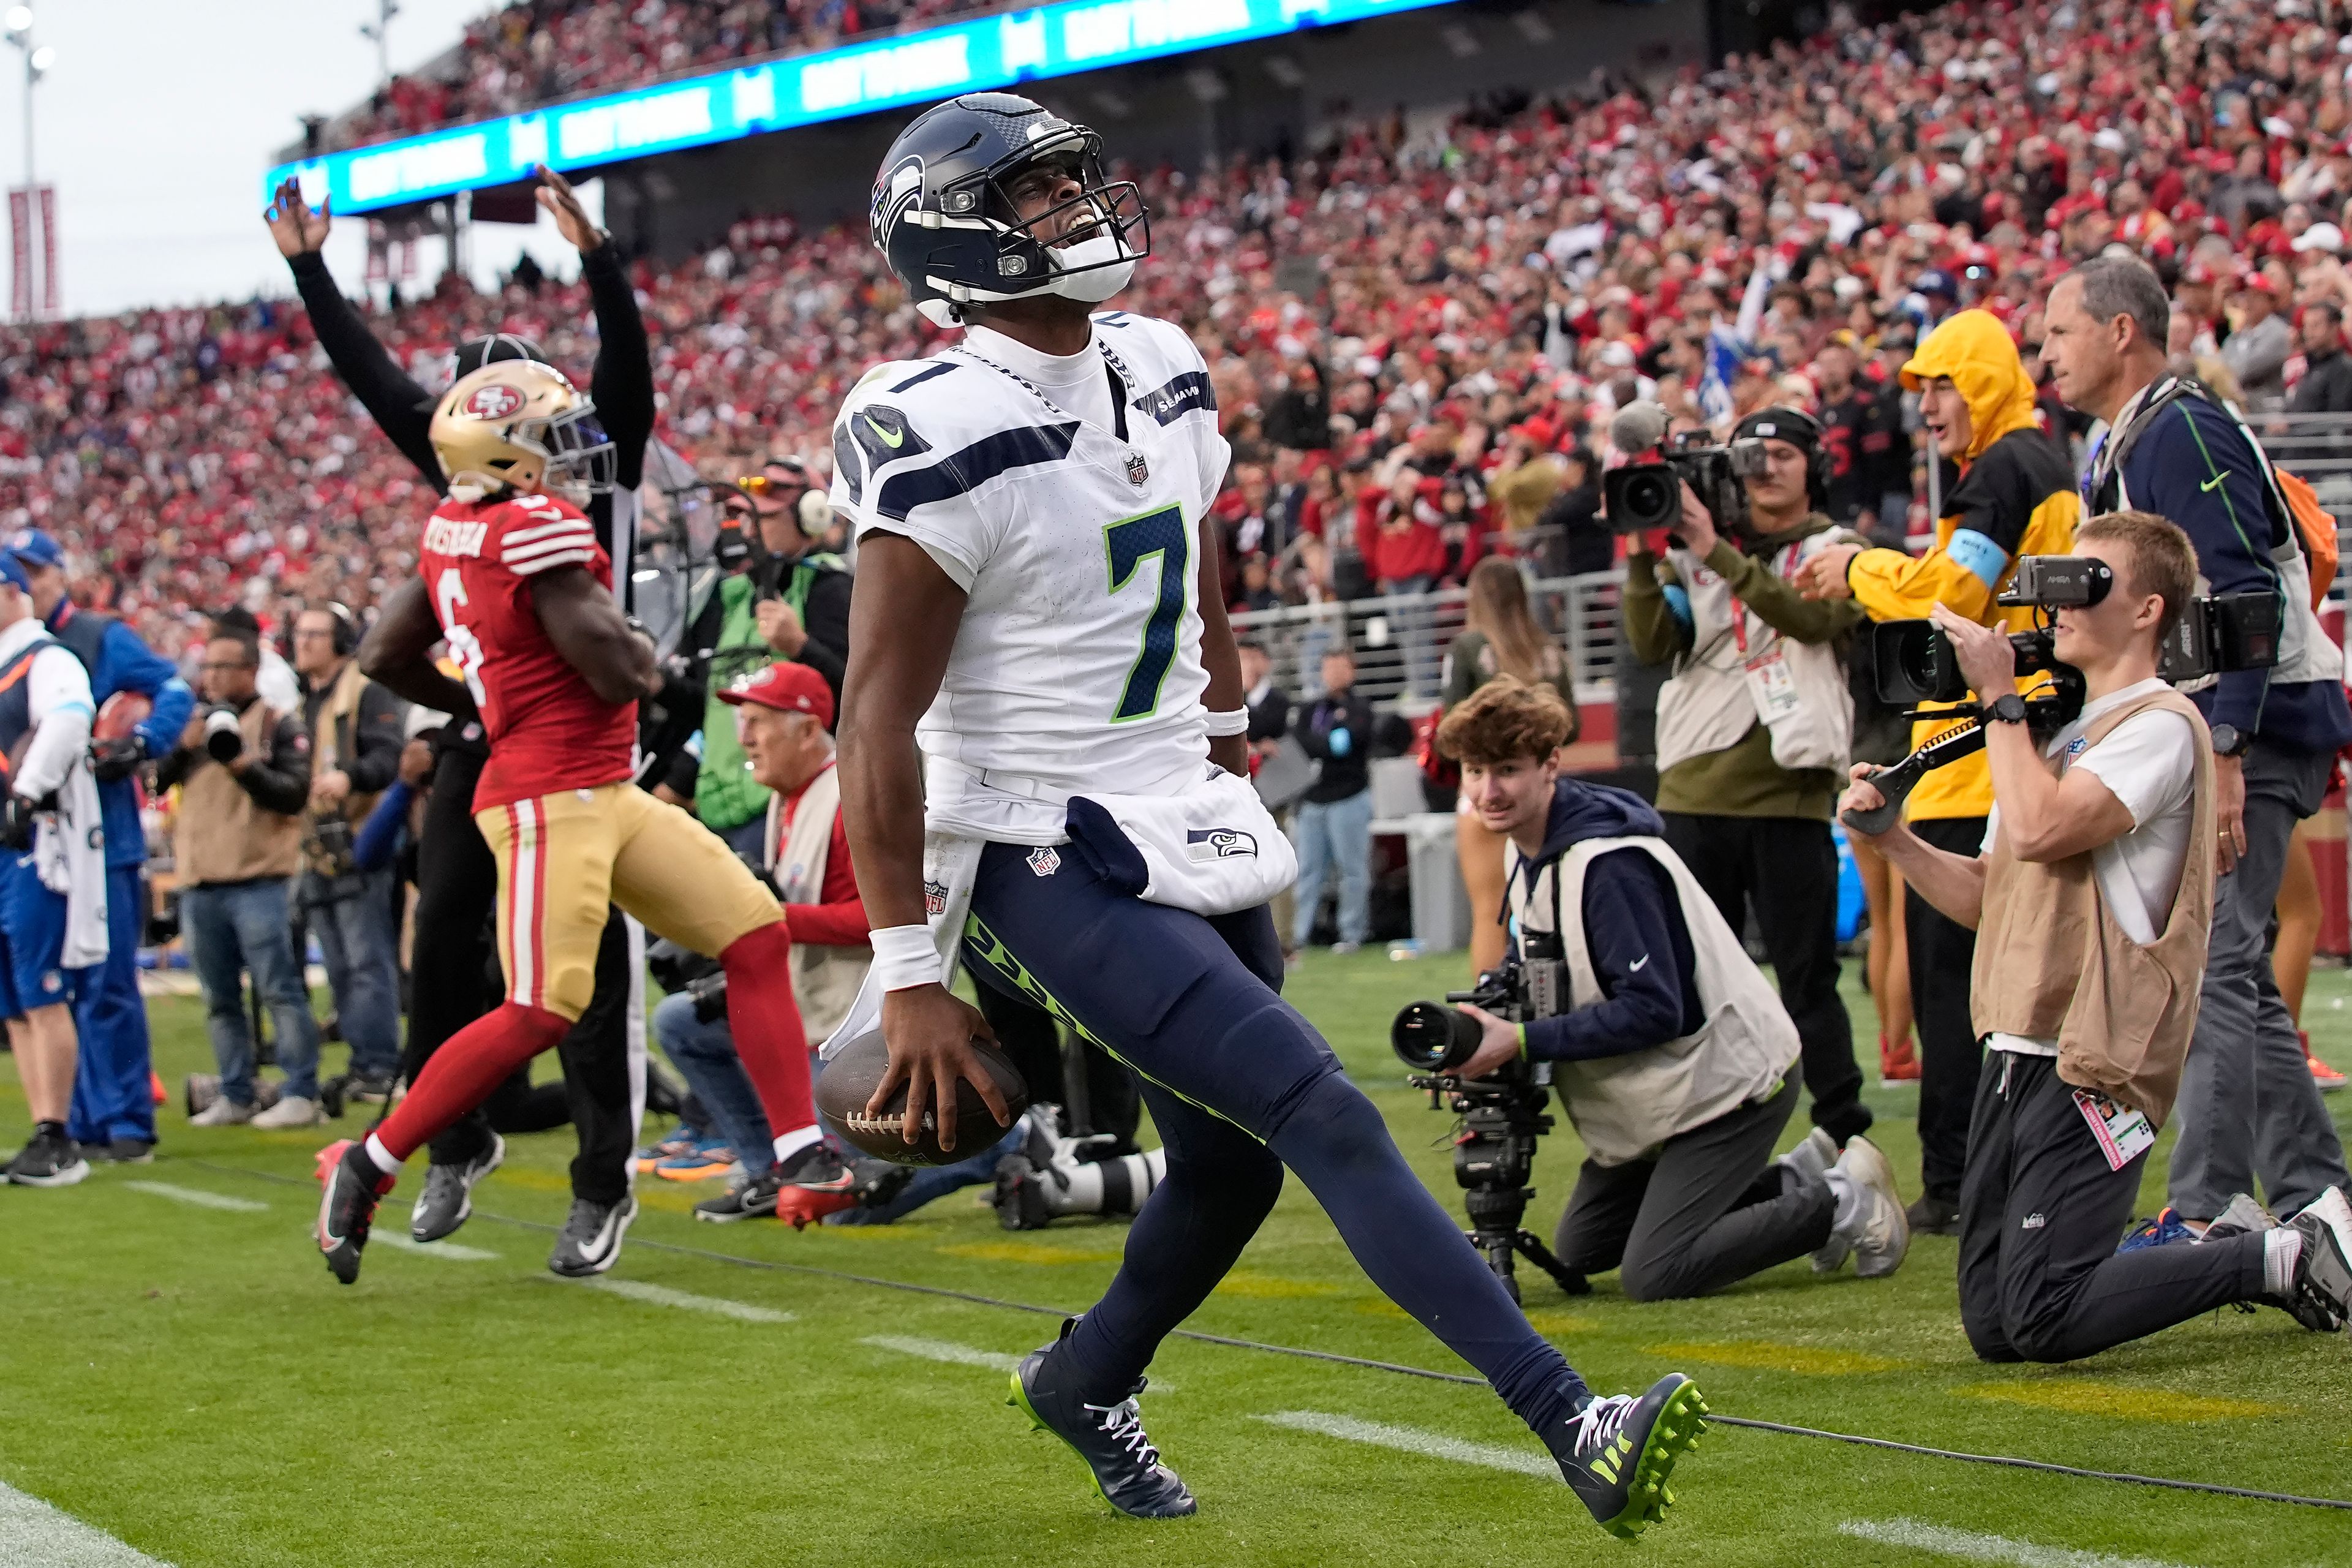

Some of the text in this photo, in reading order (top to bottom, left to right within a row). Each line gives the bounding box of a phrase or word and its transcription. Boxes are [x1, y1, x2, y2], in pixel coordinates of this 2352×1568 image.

[1131, 467, 1147, 481] NFL
[437, 568, 488, 708] 6
[1102, 501, 1189, 724] 7
[1036, 855, 1057, 872] NFL
[2085, 1106, 2107, 1144] VISITING
[2103, 1140, 2120, 1168] MEDIA
